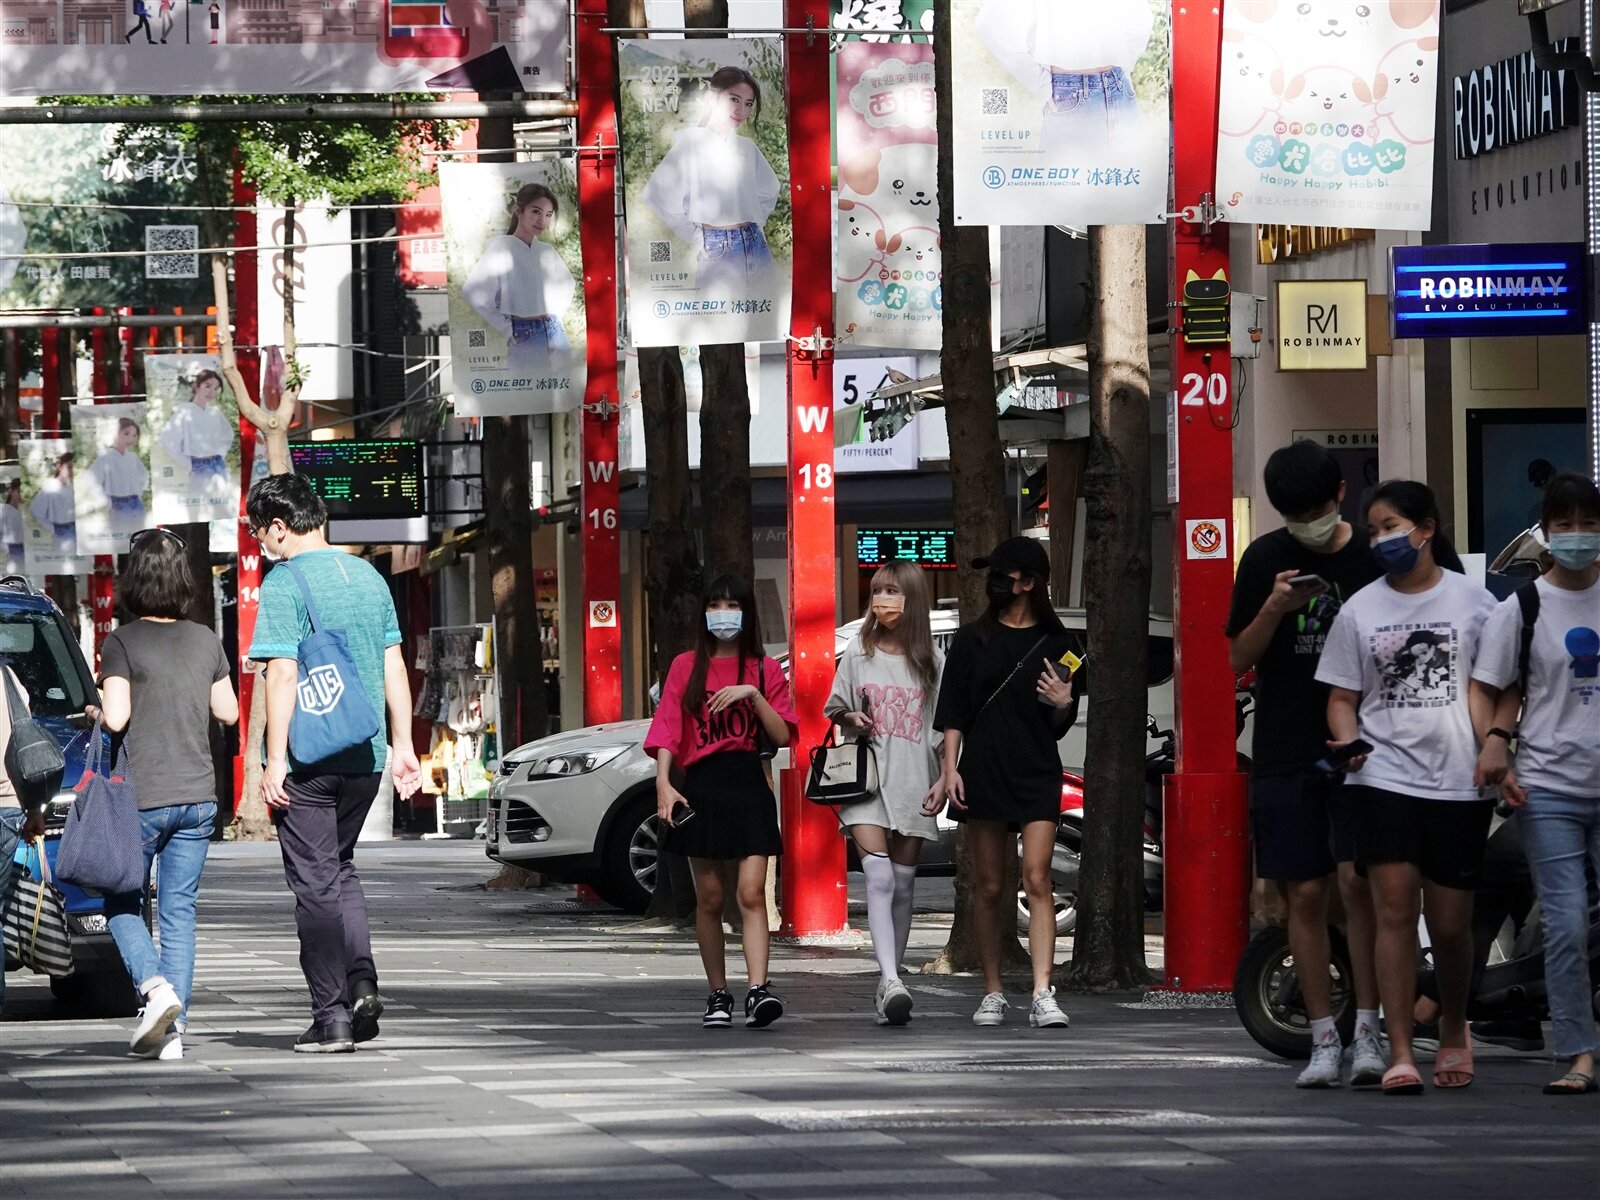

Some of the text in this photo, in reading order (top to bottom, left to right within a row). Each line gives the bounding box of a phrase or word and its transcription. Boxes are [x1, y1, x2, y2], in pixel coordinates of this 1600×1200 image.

[522, 65, 541, 76] 廣告
[641, 65, 679, 84] 2021
[642, 96, 680, 113] NEW
[1453, 37, 1568, 160] ROBINMAY
[981, 130, 1031, 140] LEVEL UP
[1011, 168, 1080, 179] ONE BOY
[1086, 167, 1141, 186] 冰鋒衣
[1259, 173, 1389, 190] Happy Happy Habibi
[1471, 160, 1582, 215] EVOLUTION
[650, 273, 676, 281] LEVEL
[1420, 276, 1564, 299] ROBINMAY
[674, 300, 727, 311] ONE BOY
[731, 299, 772, 314] 冰鋒衣
[1425, 302, 1560, 311] EVOLUTION
[869, 309, 898, 320] Happy
[903, 312, 933, 322] Happy
[1284, 337, 1362, 347] ROBINMAY
[489, 378, 533, 387] ONE BOY
[536, 378, 570, 390] 冰鋒衣
[1181, 372, 1228, 406] 20
[797, 405, 829, 433] W
[588, 461, 615, 483] W
[798, 463, 832, 489] 18
[588, 508, 617, 529] 16
[241, 555, 259, 571] W
[96, 596, 111, 609] W
[241, 586, 260, 603] 14
[96, 622, 112, 633] 10
[302, 670, 339, 709] DUS
